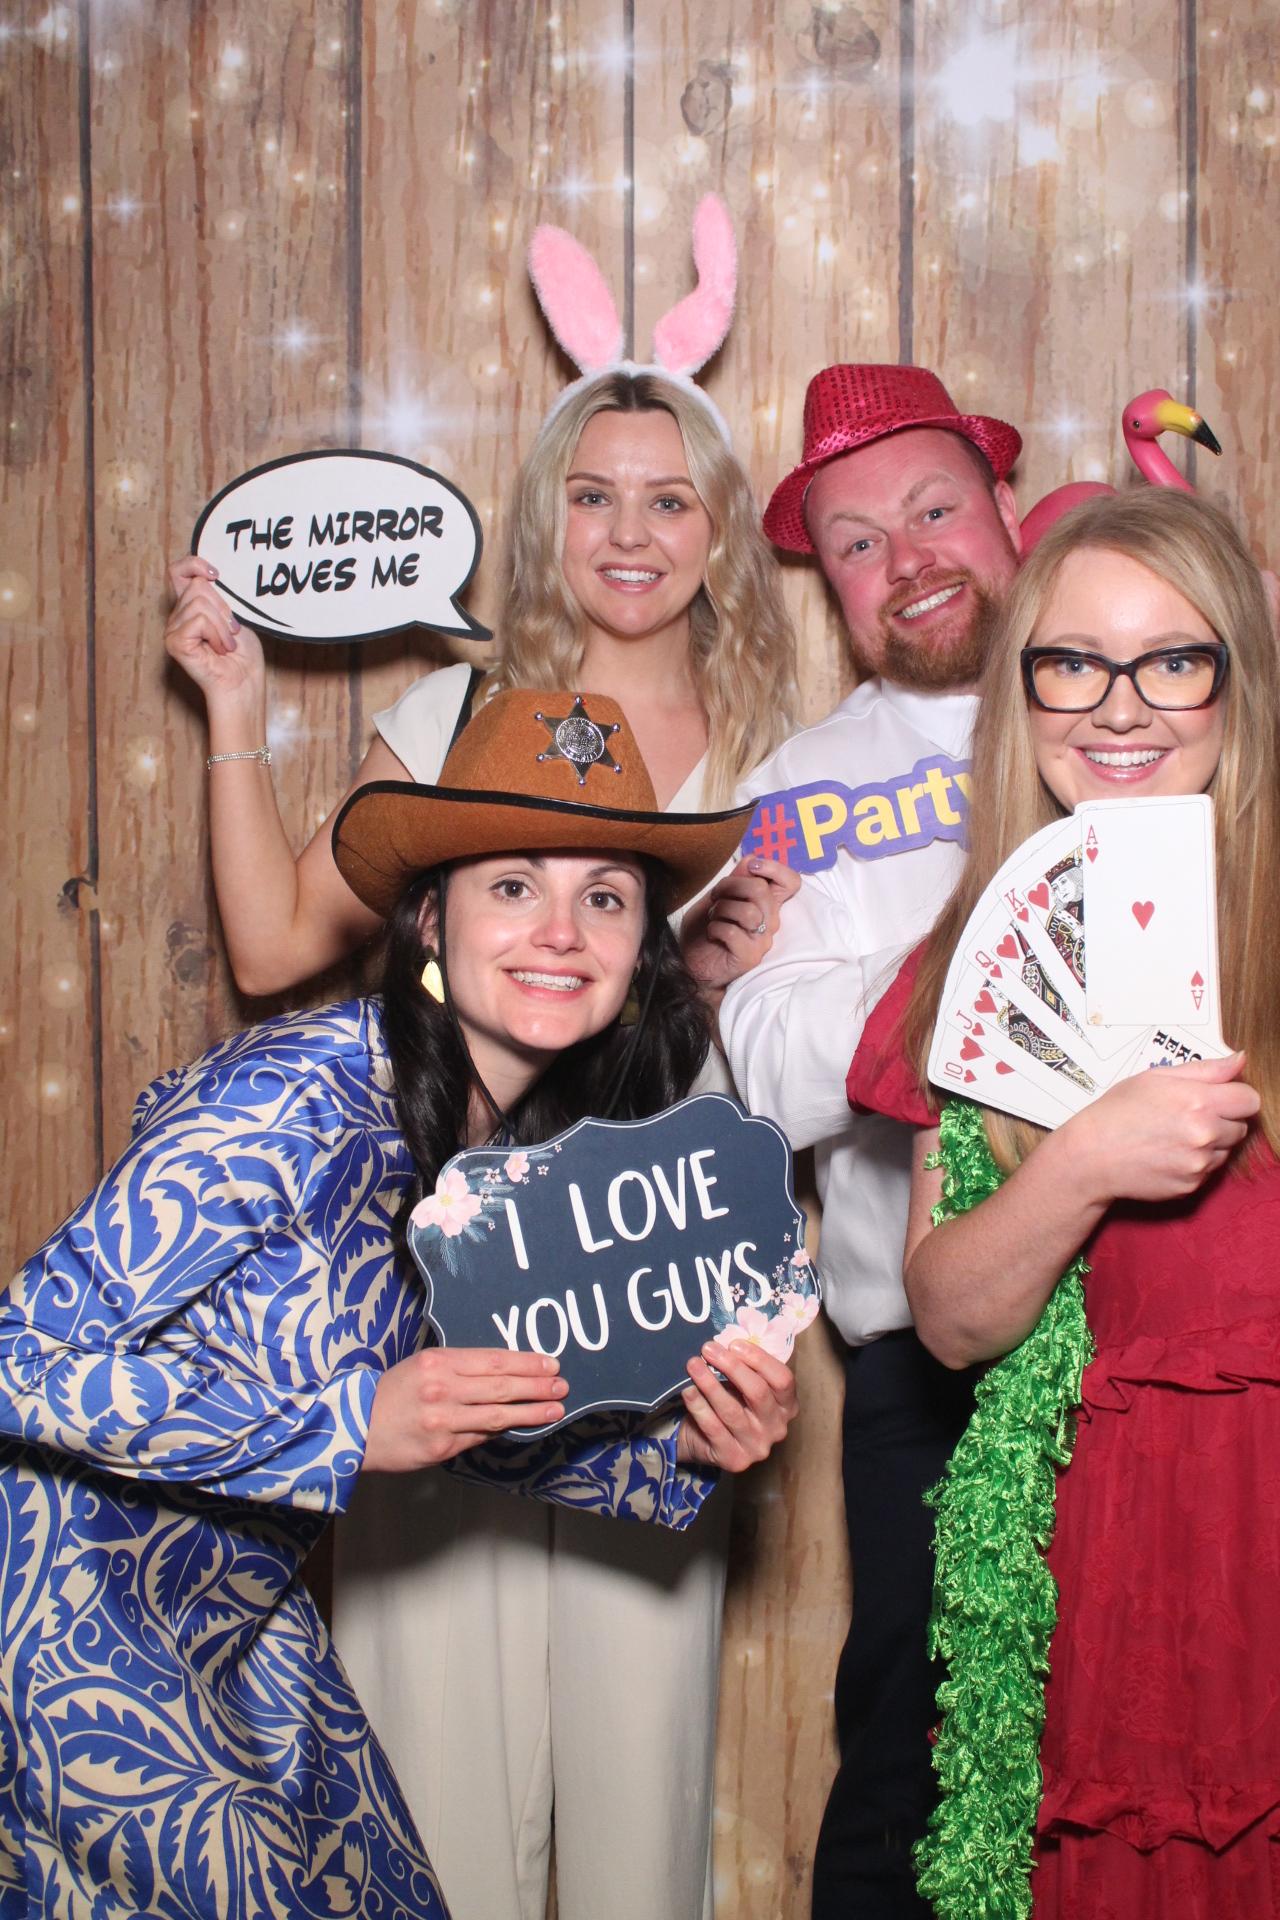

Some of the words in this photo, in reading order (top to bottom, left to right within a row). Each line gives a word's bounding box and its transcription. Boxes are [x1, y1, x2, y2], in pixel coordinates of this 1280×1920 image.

[226, 516, 294, 552] THE
[308, 505, 444, 547] MIRROR
[256, 557, 357, 597] LOVES
[371, 552, 420, 589] ME
[1085, 824, 1099, 845] A
[1004, 887, 1025, 912] K
[975, 950, 995, 968] Q
[1190, 989, 1205, 1010] A
[956, 1010, 973, 1030] J
[944, 1061, 963, 1080] 10
[504, 1198, 529, 1269] I
[568, 1149, 730, 1253] LOVE
[491, 1283, 609, 1358] YOU
[627, 1241, 772, 1331] GUYS
